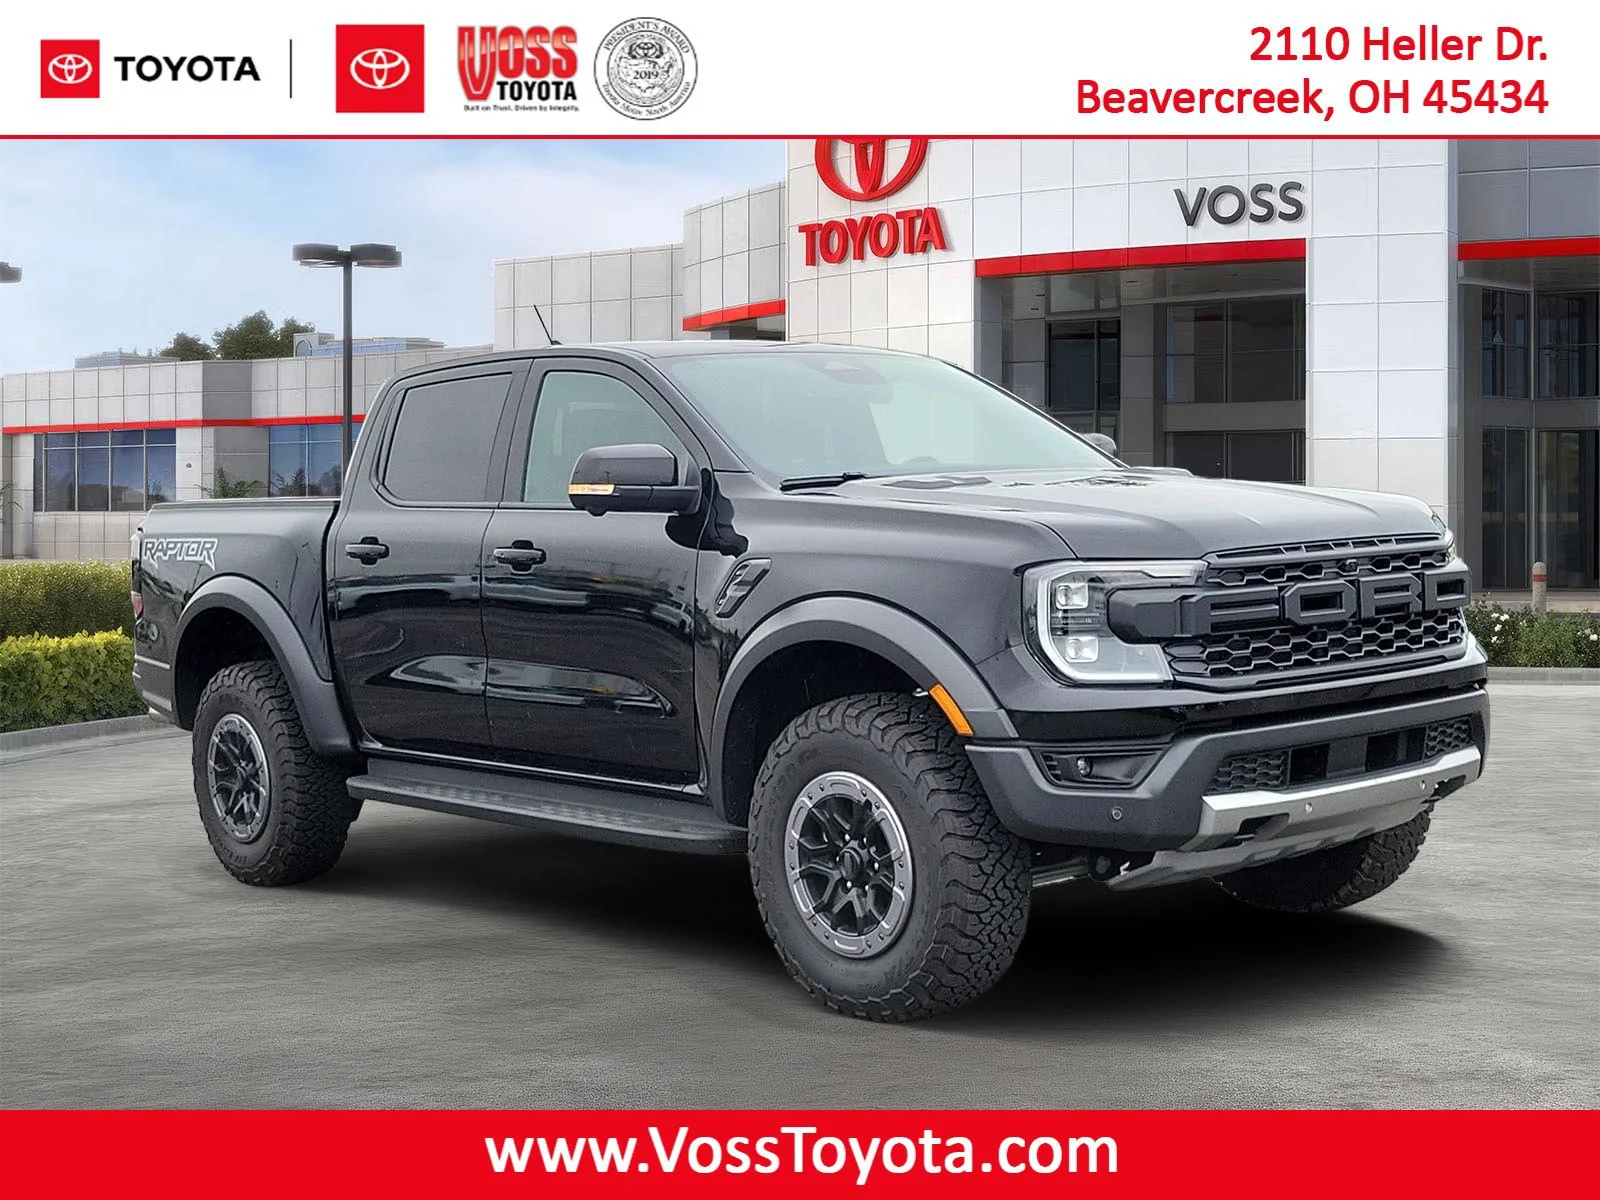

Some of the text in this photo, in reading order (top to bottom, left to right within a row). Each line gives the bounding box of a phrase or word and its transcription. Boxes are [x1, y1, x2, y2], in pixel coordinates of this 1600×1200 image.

[1173, 181, 1304, 227] VOSS
[798, 207, 947, 266] TOYOTA
[143, 538, 218, 571] RAPTOR
[1186, 567, 1472, 635] FORD
